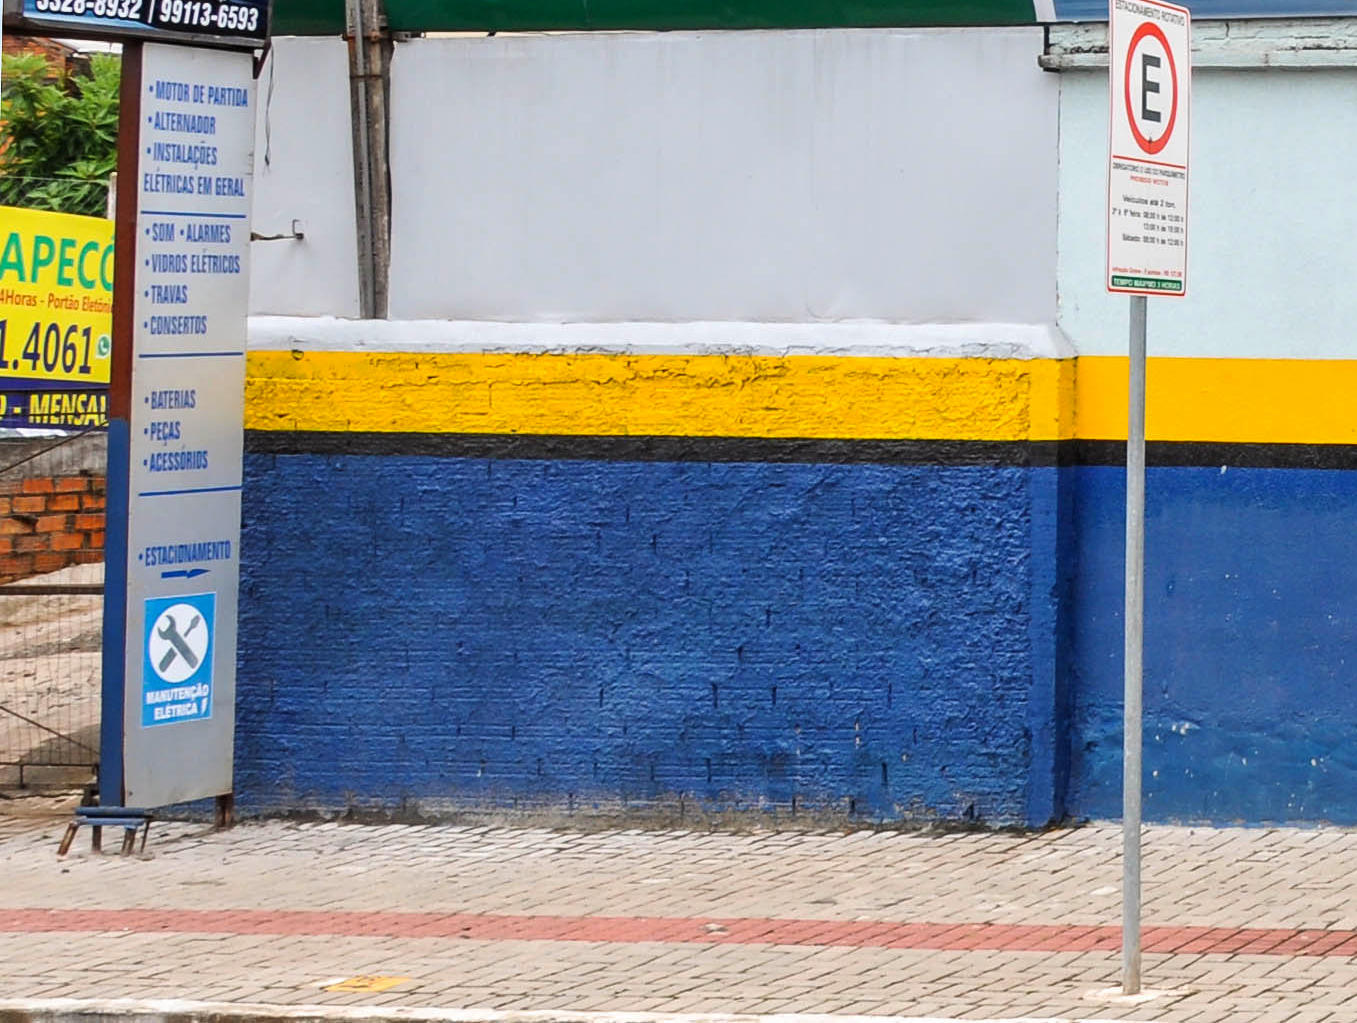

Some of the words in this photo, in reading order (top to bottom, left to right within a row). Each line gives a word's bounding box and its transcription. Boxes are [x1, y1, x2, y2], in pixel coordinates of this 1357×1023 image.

[156, 80, 190, 103] MOTOR
[193, 85, 204, 104] DE
[208, 86, 248, 107] PARTIDA
[154, 111, 216, 135] ALTERNADOR
[198, 177, 212, 195] EM
[215, 178, 245, 196] GERAL
[152, 223, 174, 242] SOM
[186, 224, 231, 243] ALARMES
[151, 254, 187, 273] VIDROS
[48, 293, 79, 310] Portão
[151, 285, 188, 304] TRAVAS
[150, 315, 207, 335] CONSERTOS
[151, 390, 196, 410] BATERIAS
[150, 422, 181, 445] PEÇAS
[145, 540, 231, 567] ESTACIONAMENTO
